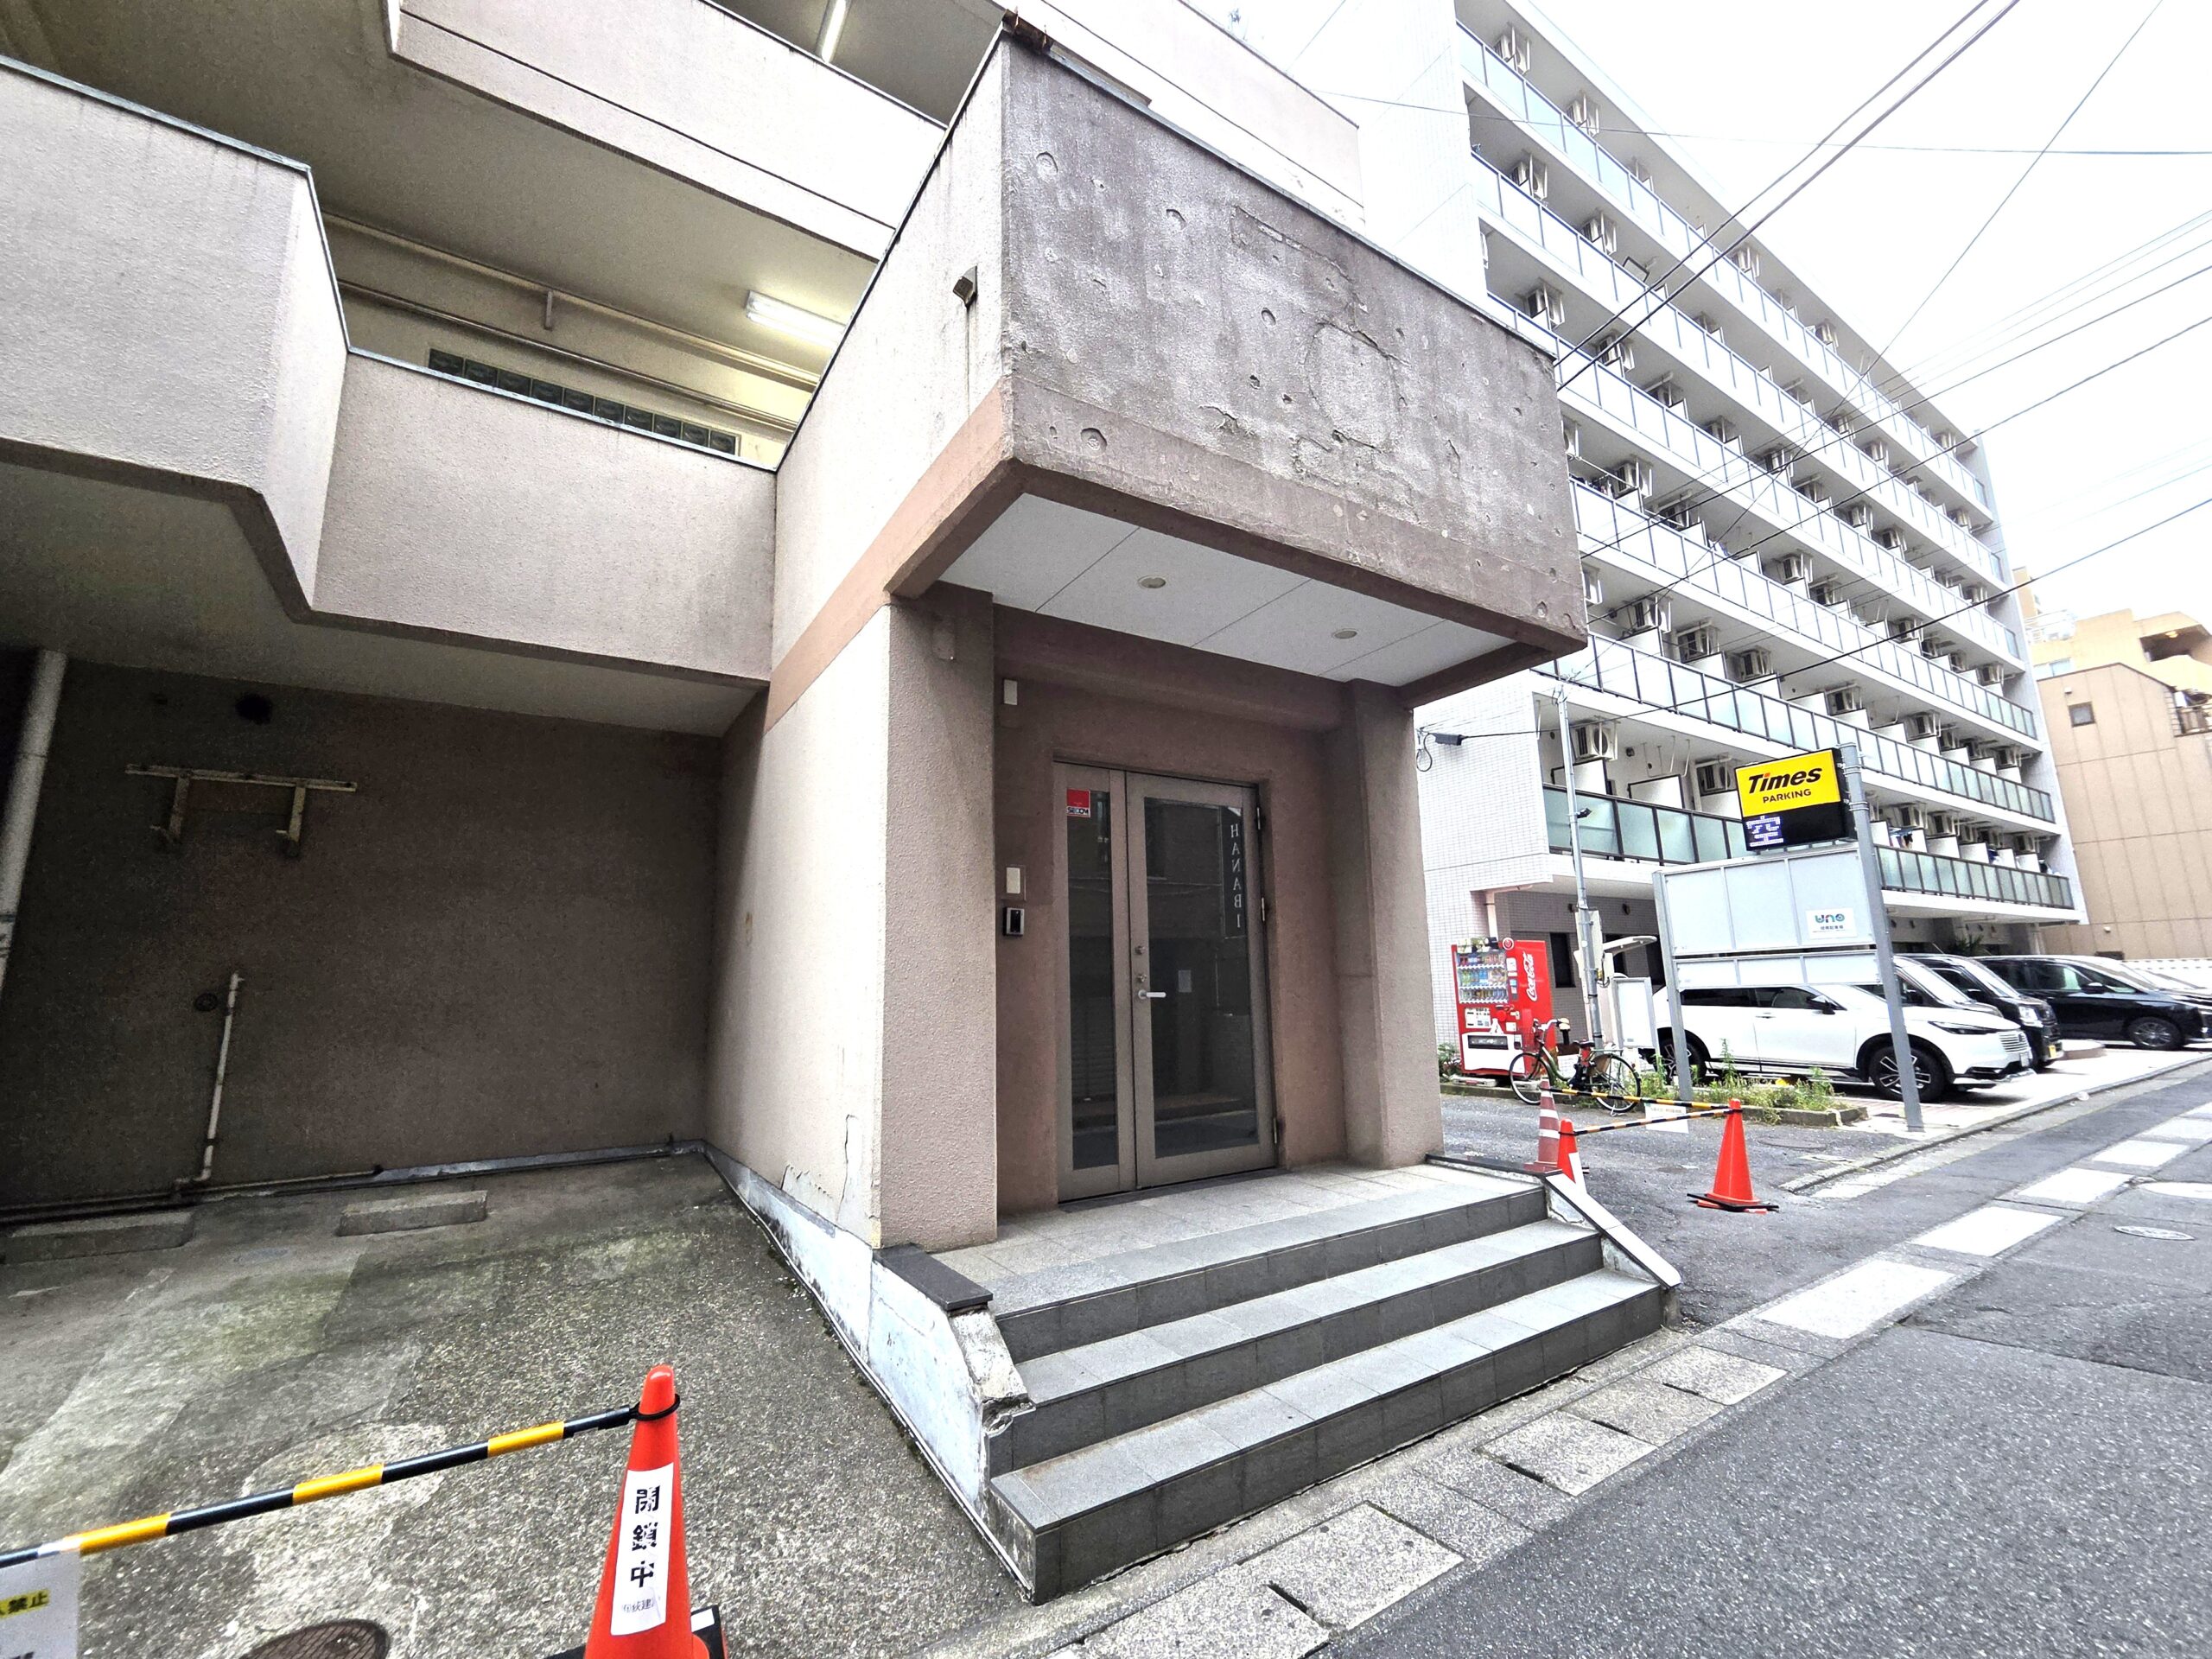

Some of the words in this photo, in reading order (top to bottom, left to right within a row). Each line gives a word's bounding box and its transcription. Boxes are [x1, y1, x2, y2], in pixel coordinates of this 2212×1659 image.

[1748, 767, 1823, 794] Times
[1762, 788, 1812, 804] PARKING
[1745, 815, 1783, 847] 空
